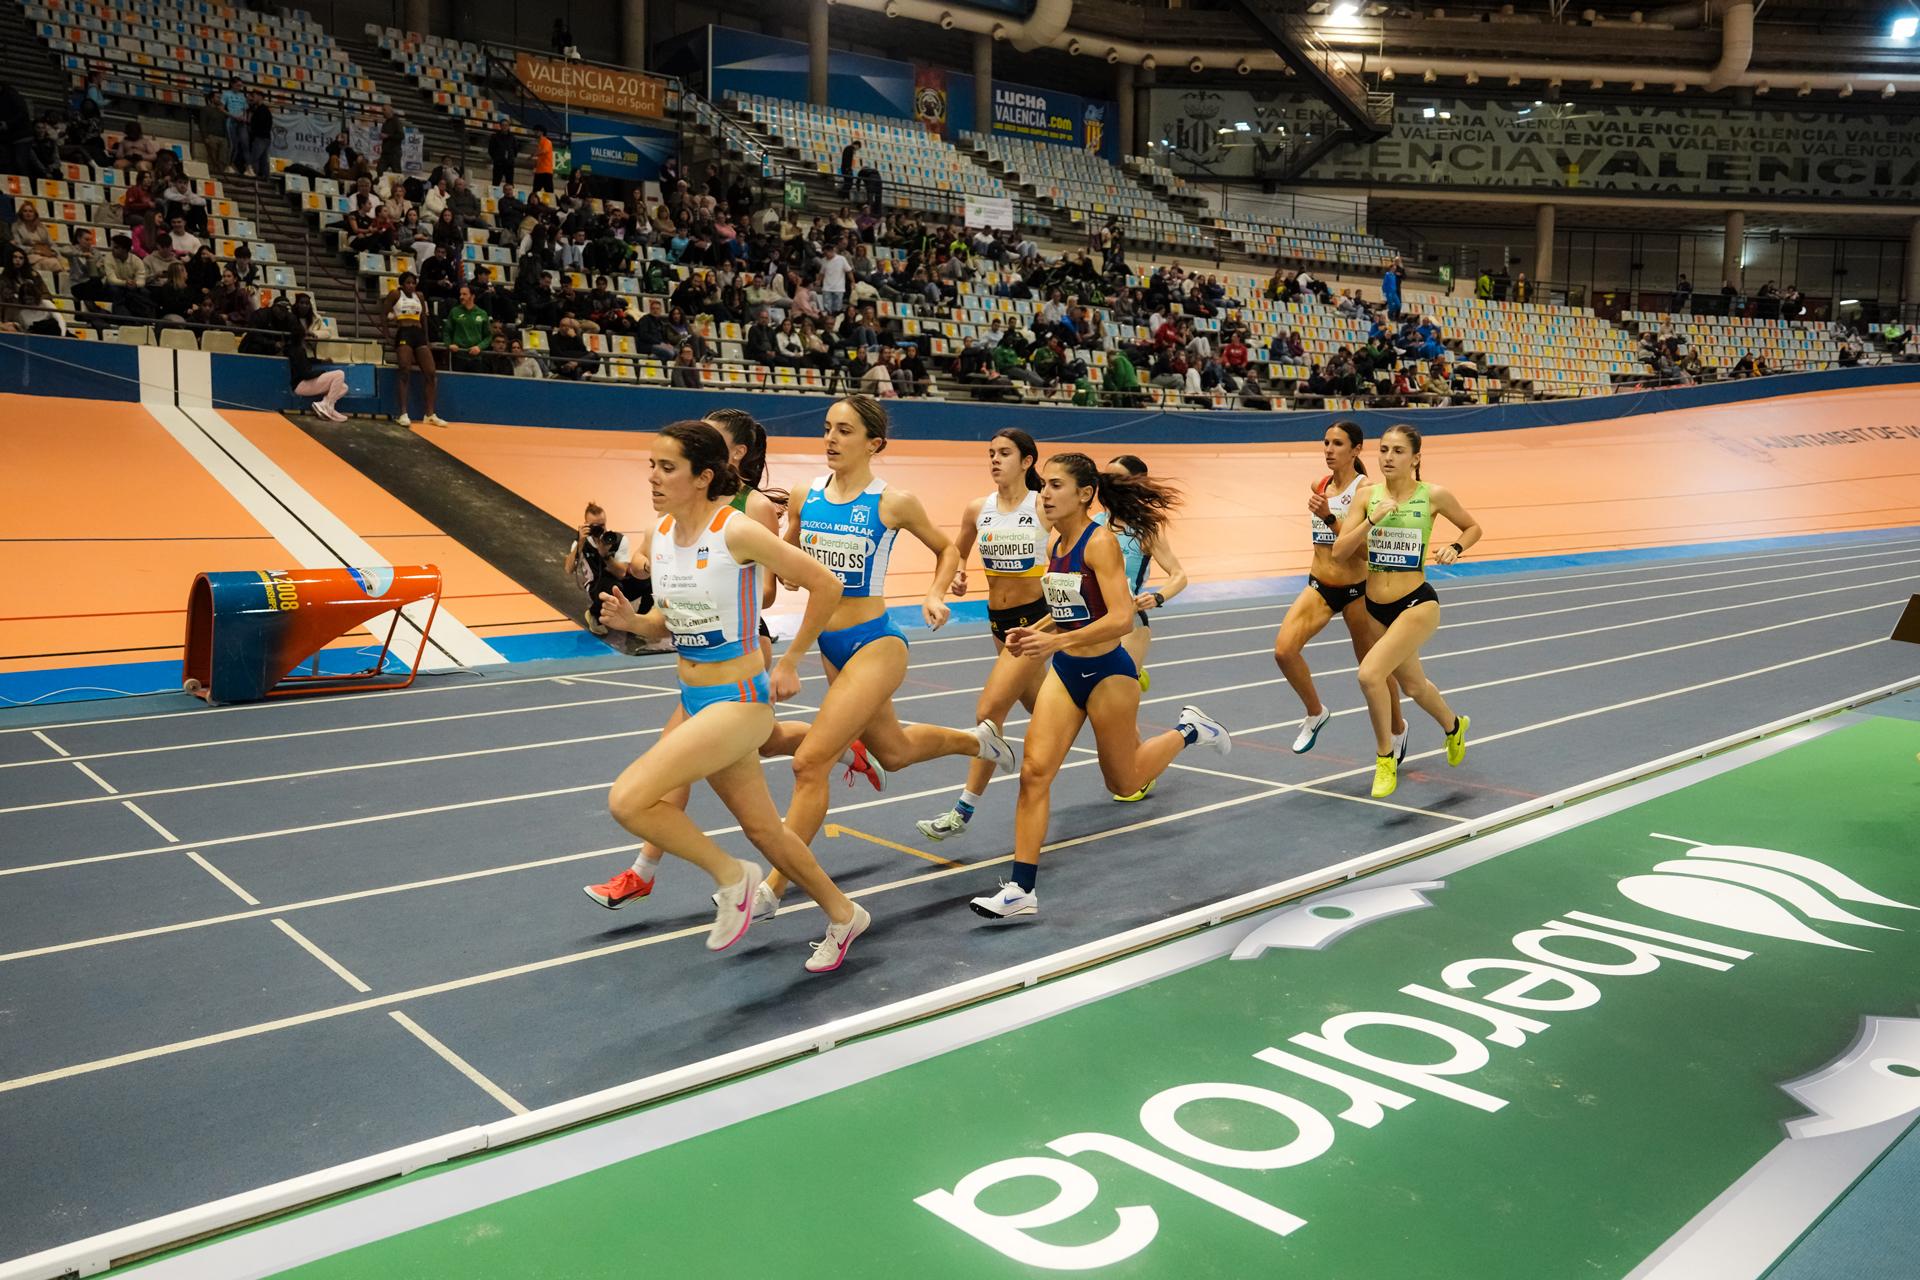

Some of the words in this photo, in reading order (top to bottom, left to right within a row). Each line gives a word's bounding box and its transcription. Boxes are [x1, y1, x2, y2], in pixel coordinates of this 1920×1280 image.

[528, 62, 615, 93] VALENCIA
[618, 77, 656, 100] 2011
[527, 80, 576, 98] European
[579, 88, 614, 105] Capital
[617, 93, 627, 106] of
[630, 99, 655, 112] Sport
[996, 89, 1047, 111] LUCHA
[995, 105, 1047, 128] VALENCIA
[1495, 117, 1577, 131] VALENCIA
[1588, 121, 1718, 138] VALENCIA
[1730, 126, 1839, 142] VALENCIA
[1401, 127, 1496, 143] VALENCIA
[1507, 131, 1655, 148] VALENCIA
[1668, 137, 1792, 155] VALENCIA
[1802, 144, 1914, 158] VALENCIA
[834, 523, 875, 536] KIROLAK
[980, 543, 1034, 556] GRUPOMPLEO
[1393, 541, 1410, 551] JAEN
[849, 554, 864, 569] SS
[273, 577, 299, 611] 2008
